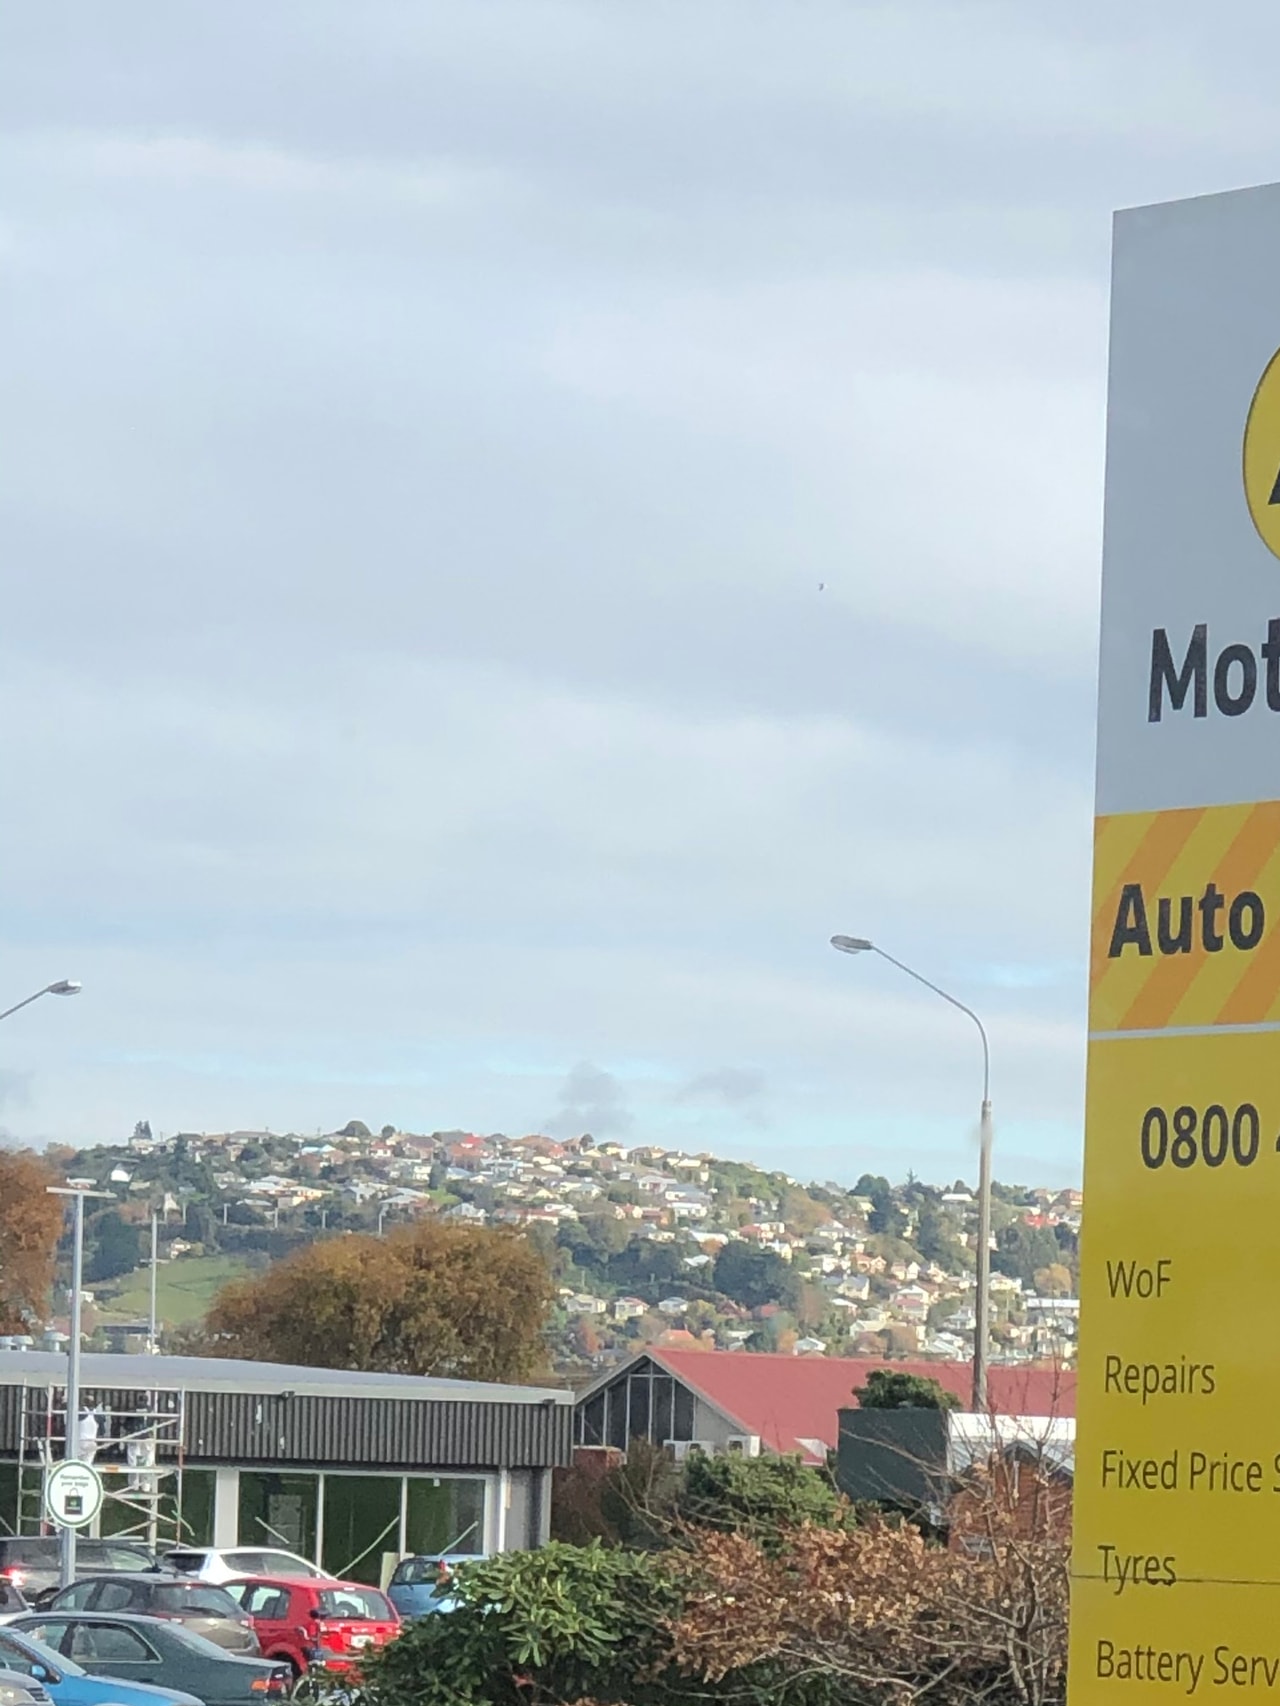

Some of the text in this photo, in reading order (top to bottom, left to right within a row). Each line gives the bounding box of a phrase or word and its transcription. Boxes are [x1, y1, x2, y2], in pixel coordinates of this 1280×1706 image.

[1108, 883, 1265, 959] Auto
[1141, 1103, 1260, 1170] 0800
[1106, 1259, 1172, 1299] WoF
[1104, 1354, 1216, 1406] Repairs
[1102, 1448, 1179, 1490] Fixed
[1189, 1451, 1263, 1493] Price
[1097, 1544, 1177, 1596] Tyres
[1096, 1639, 1205, 1695] Battery
